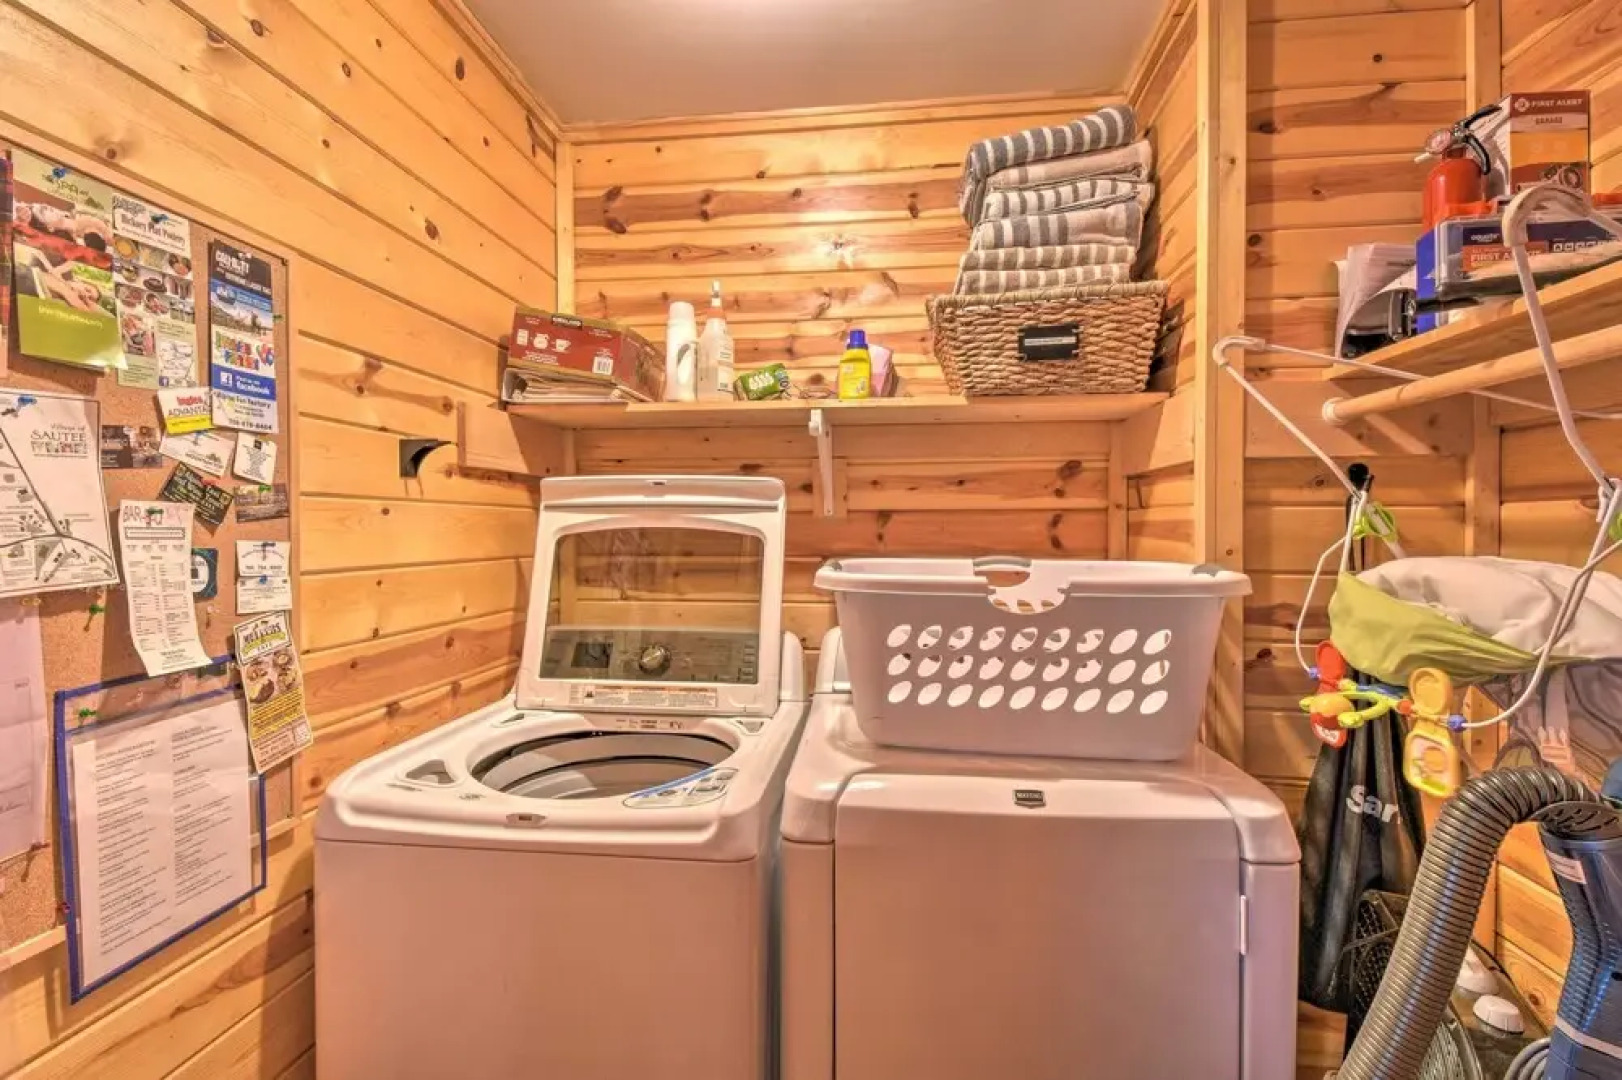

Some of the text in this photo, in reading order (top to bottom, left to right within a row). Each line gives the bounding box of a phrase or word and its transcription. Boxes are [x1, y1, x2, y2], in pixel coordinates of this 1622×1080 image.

[1556, 98, 1583, 107] ALERT
[1471, 252, 1500, 262] FIRST
[236, 380, 270, 395] facebook
[30, 430, 87, 442] SAUTEE
